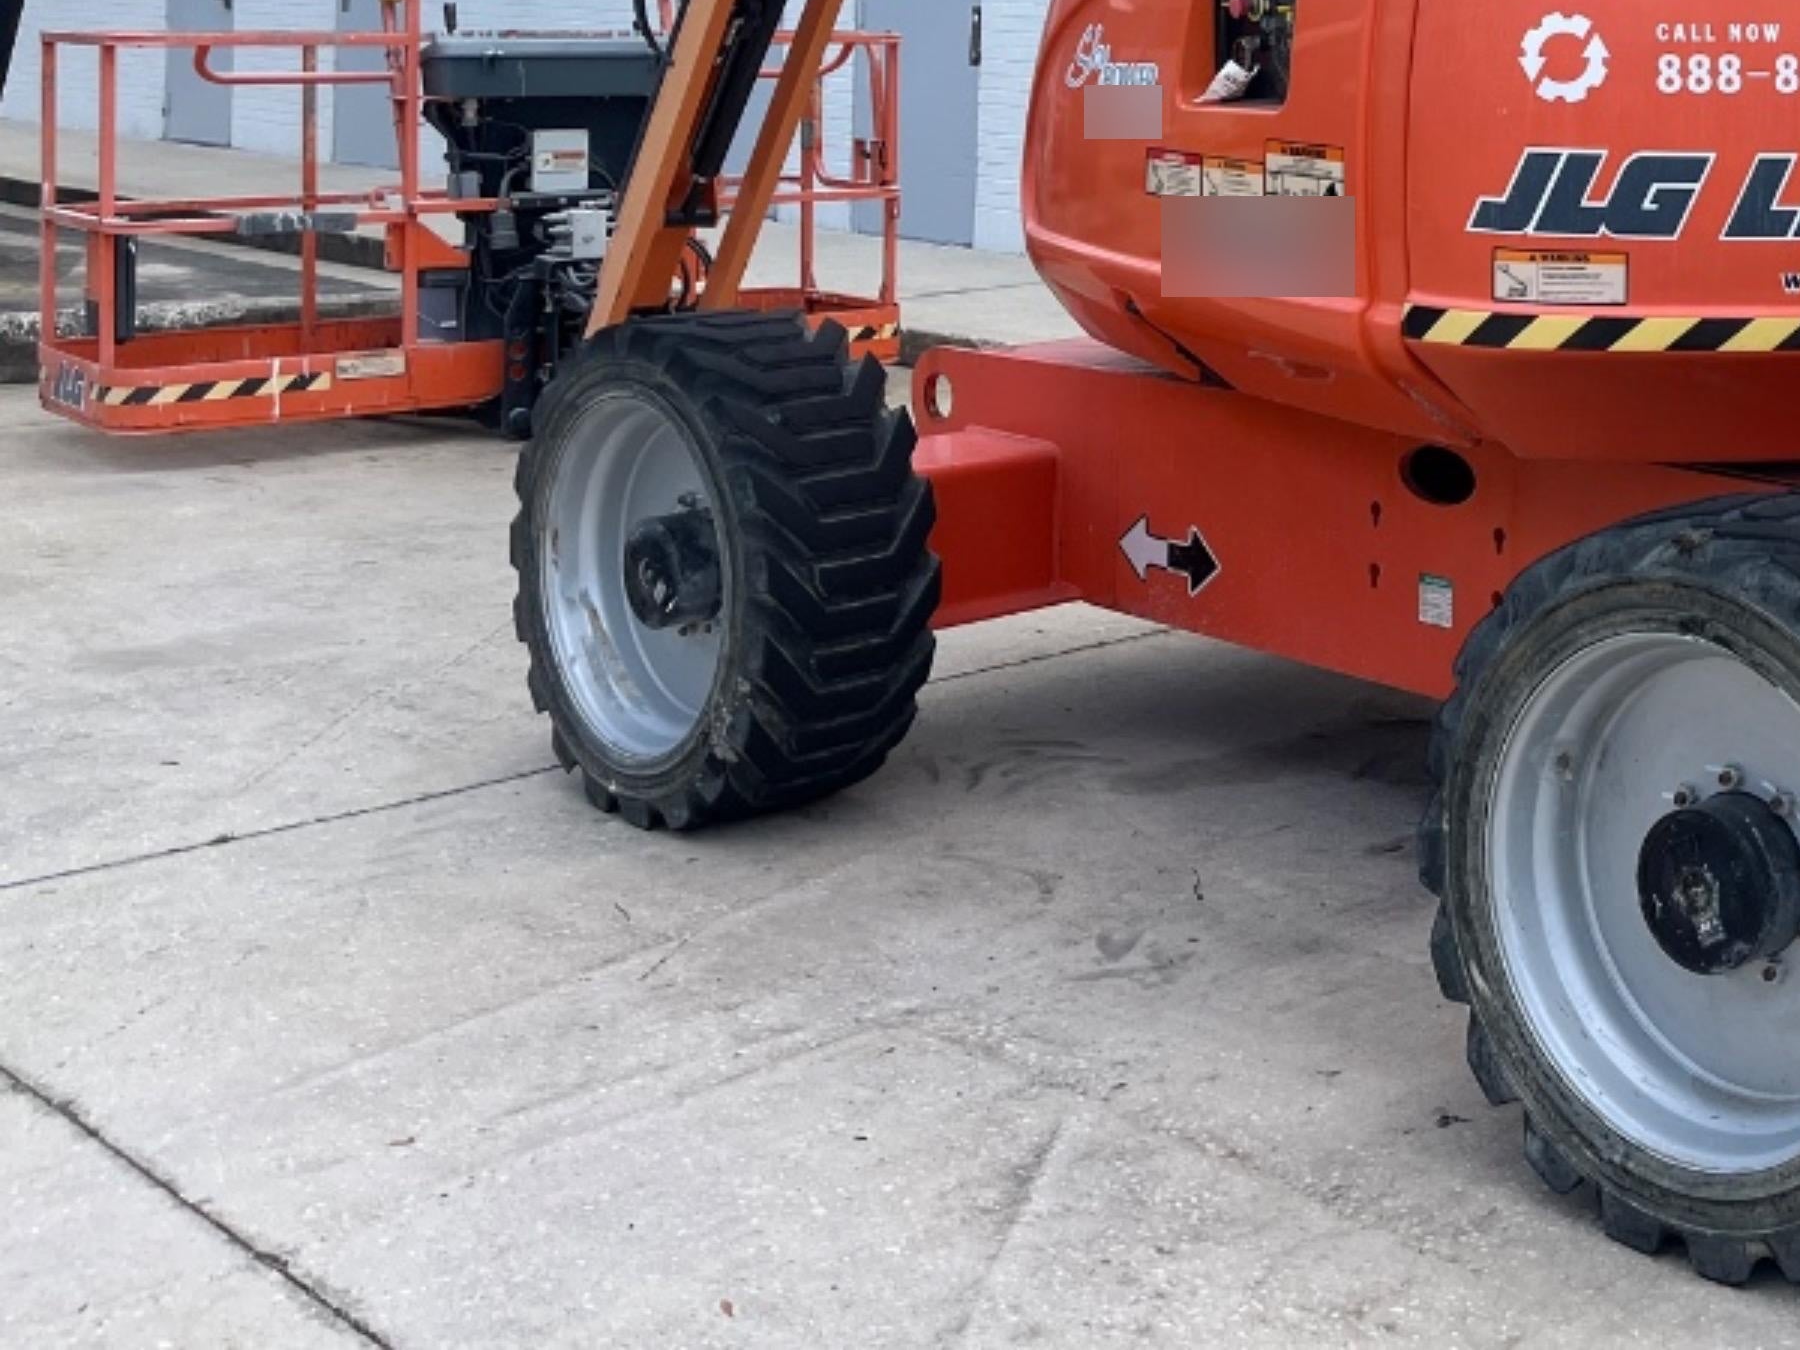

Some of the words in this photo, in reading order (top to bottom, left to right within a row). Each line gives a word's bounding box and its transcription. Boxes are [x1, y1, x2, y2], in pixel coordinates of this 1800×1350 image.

[1656, 23, 1716, 42] CALL
[1728, 23, 1781, 43] NOW
[1467, 147, 1716, 240] JLG
